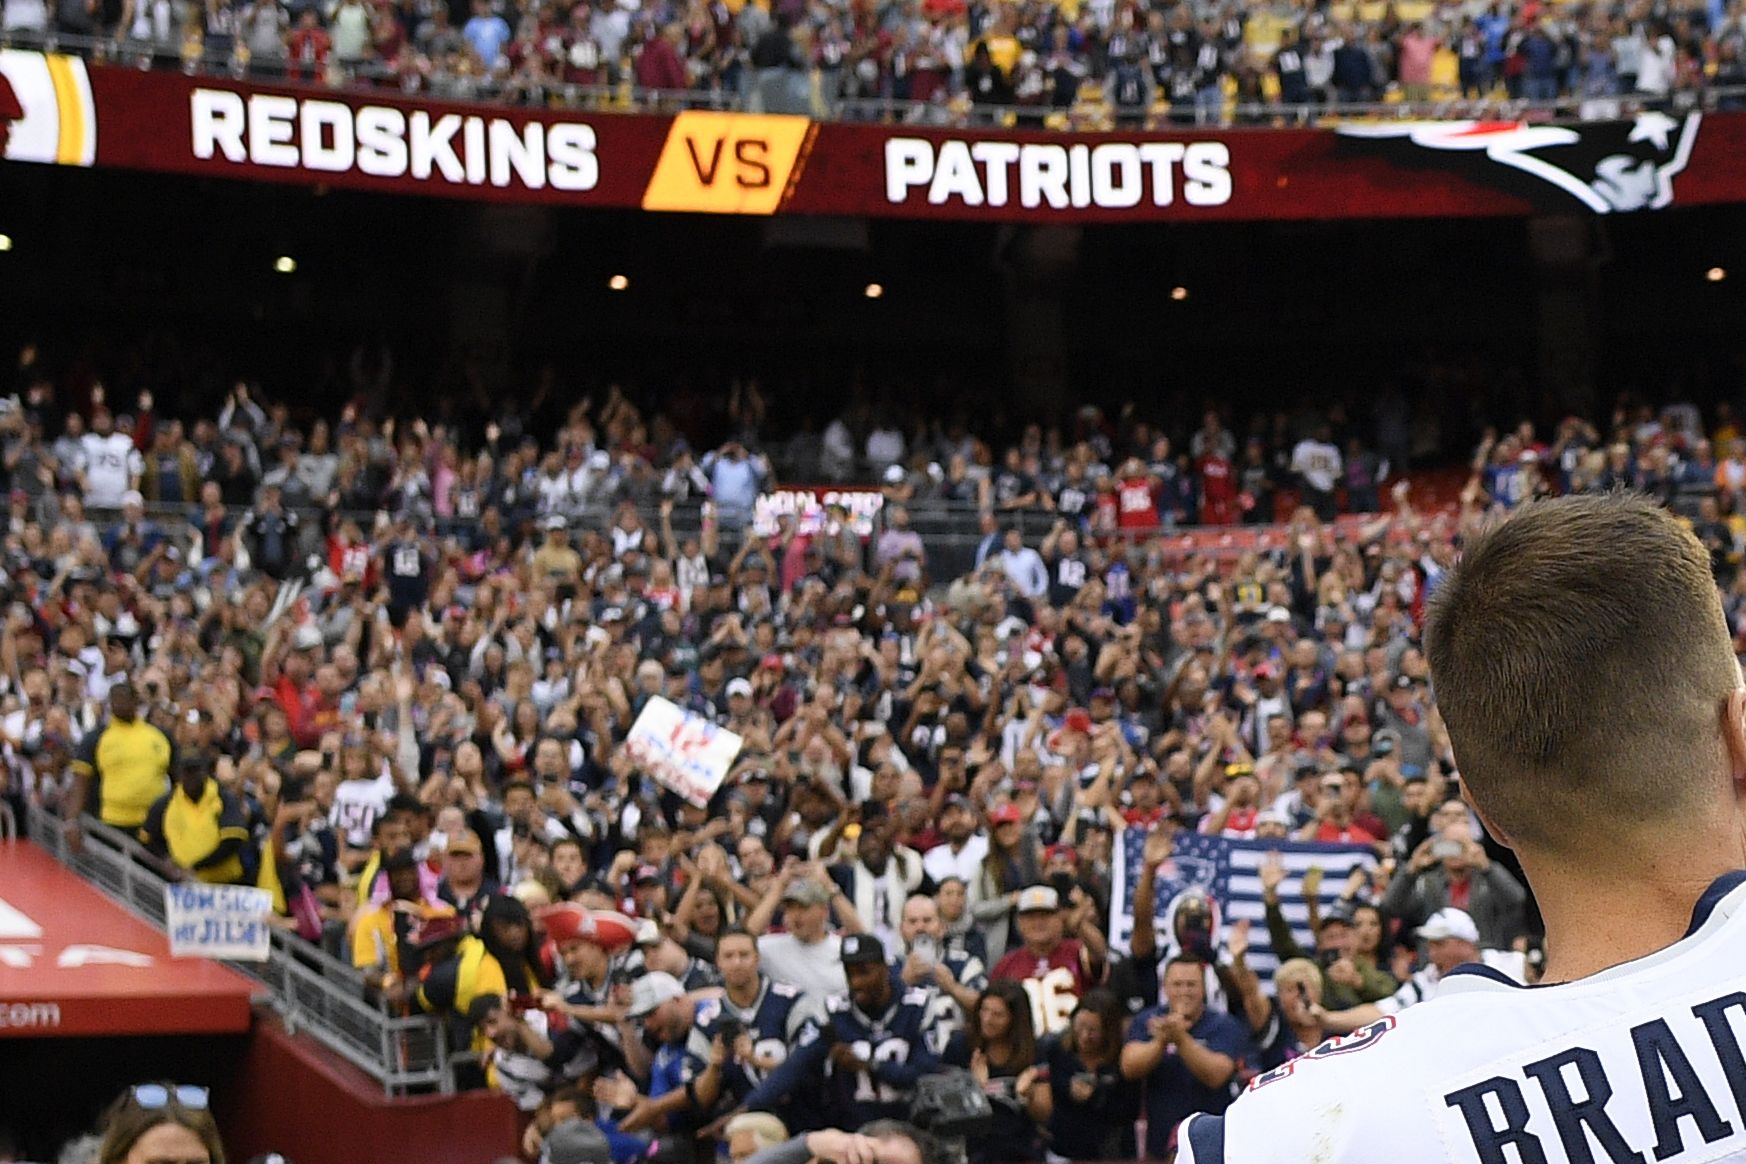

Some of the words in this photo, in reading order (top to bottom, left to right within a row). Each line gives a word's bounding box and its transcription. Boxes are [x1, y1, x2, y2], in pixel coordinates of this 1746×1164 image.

[189, 87, 600, 191] REDSKINS
[684, 135, 772, 190] VS
[884, 136, 1233, 210] PATRIOTS
